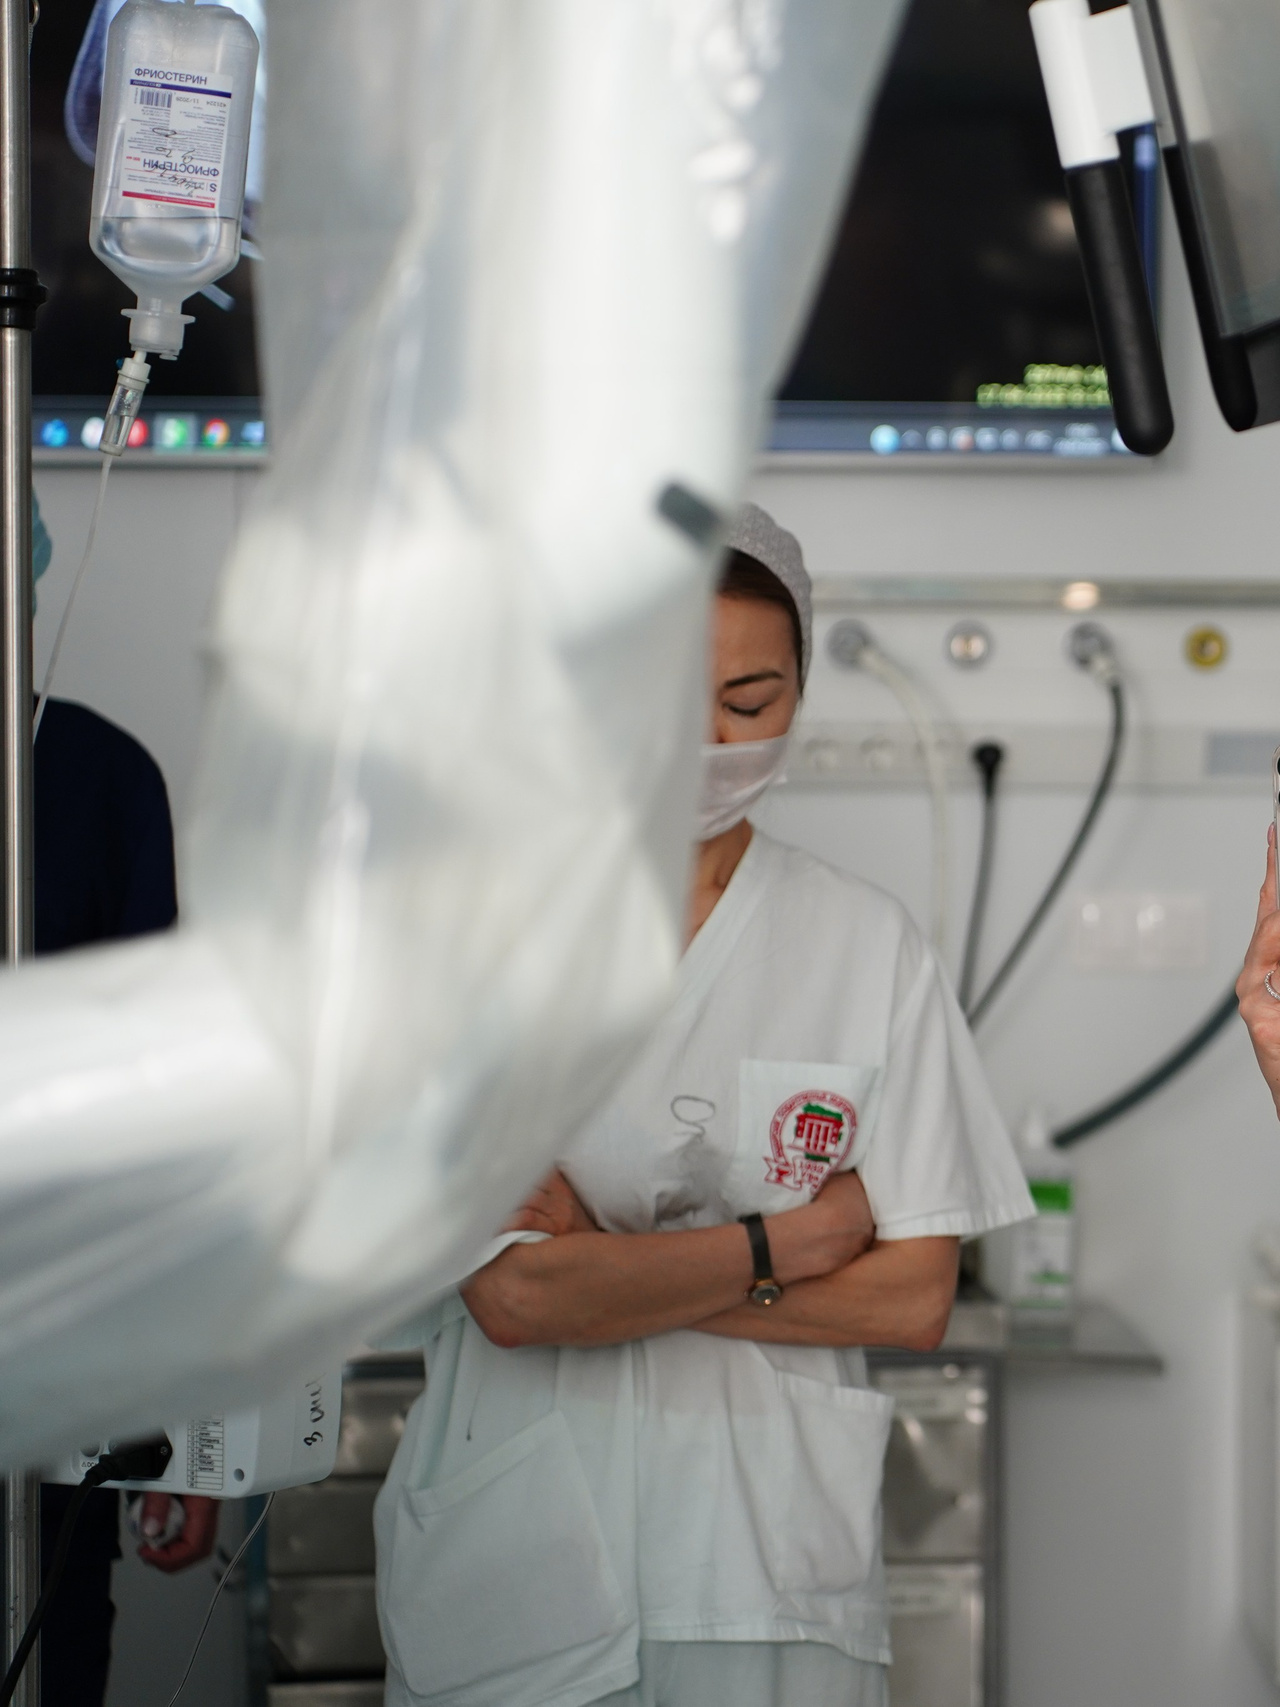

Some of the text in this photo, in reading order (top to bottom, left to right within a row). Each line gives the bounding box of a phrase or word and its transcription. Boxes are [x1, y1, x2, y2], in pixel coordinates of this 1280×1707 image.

[134, 67, 208, 86] ФРИОСТЕРИН
[143, 158, 220, 177] ФРИОСТЕРИН
[209, 183, 217, 192] S
